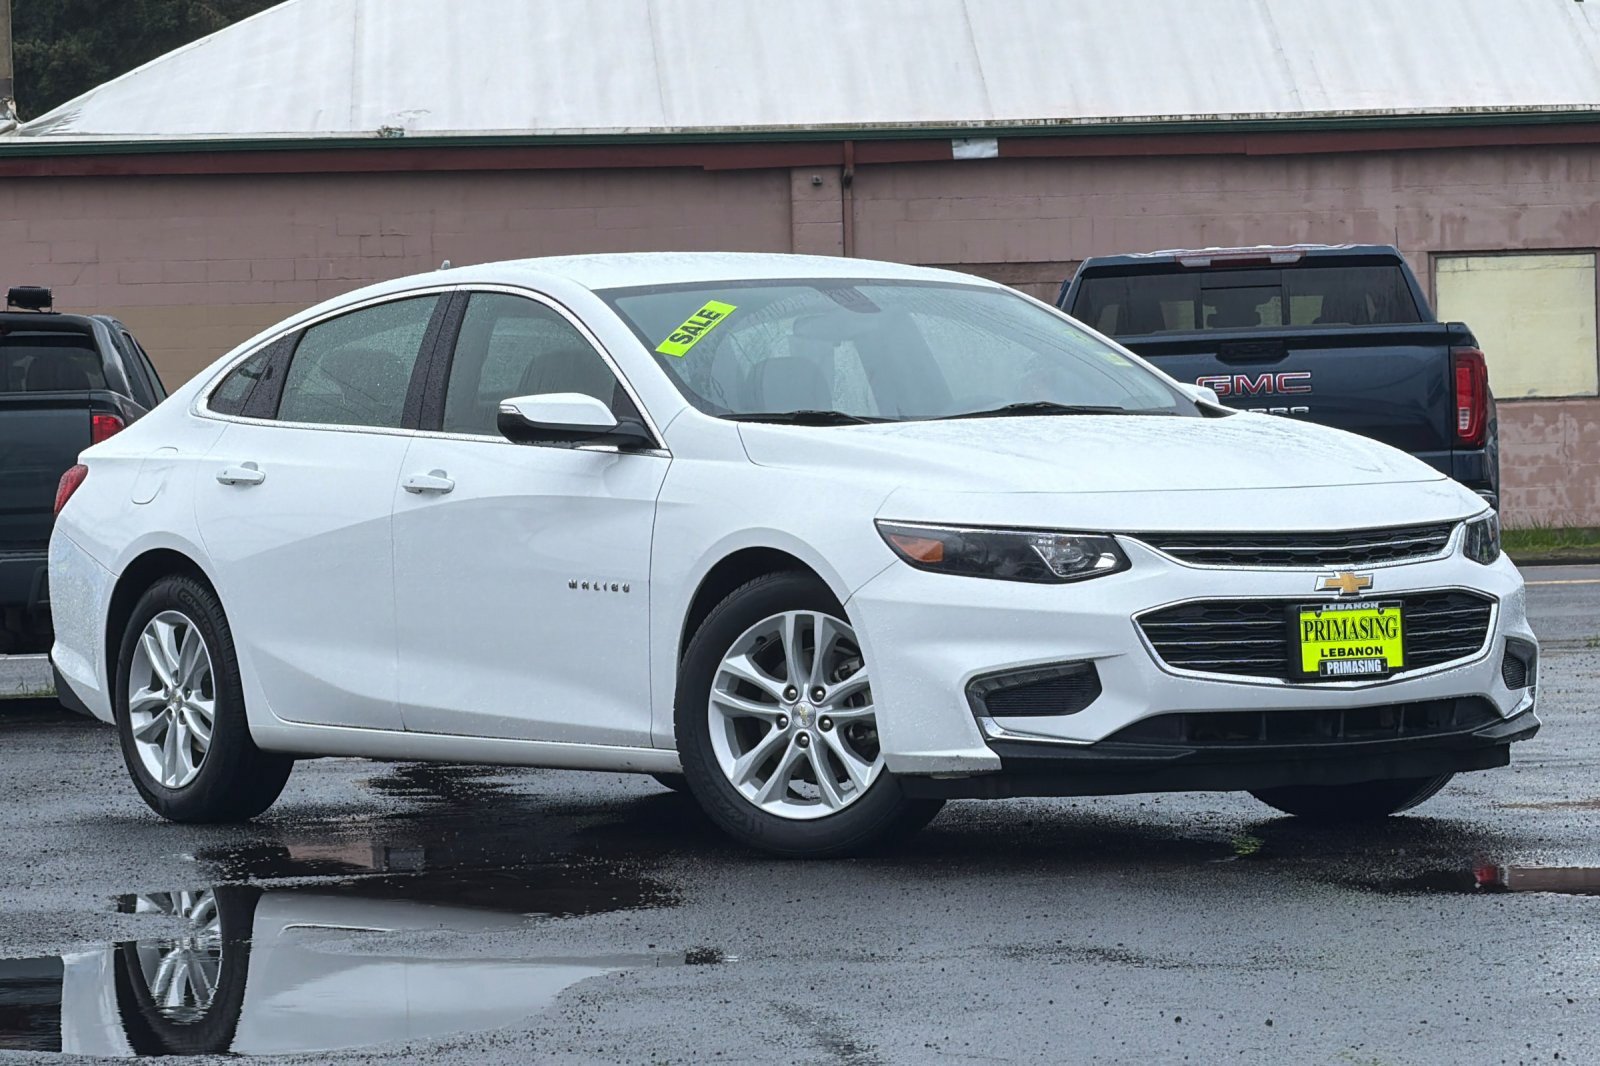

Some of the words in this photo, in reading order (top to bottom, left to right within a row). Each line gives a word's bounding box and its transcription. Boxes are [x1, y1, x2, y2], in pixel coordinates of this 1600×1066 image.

[668, 309, 722, 345] SALE
[1196, 372, 1311, 396] GMC
[568, 579, 630, 593] MALIBU
[1322, 601, 1379, 611] LEBANON
[1302, 615, 1398, 643] PRIMASING
[1321, 646, 1383, 658] LEBANON
[1326, 659, 1382, 675] PRIMASING
